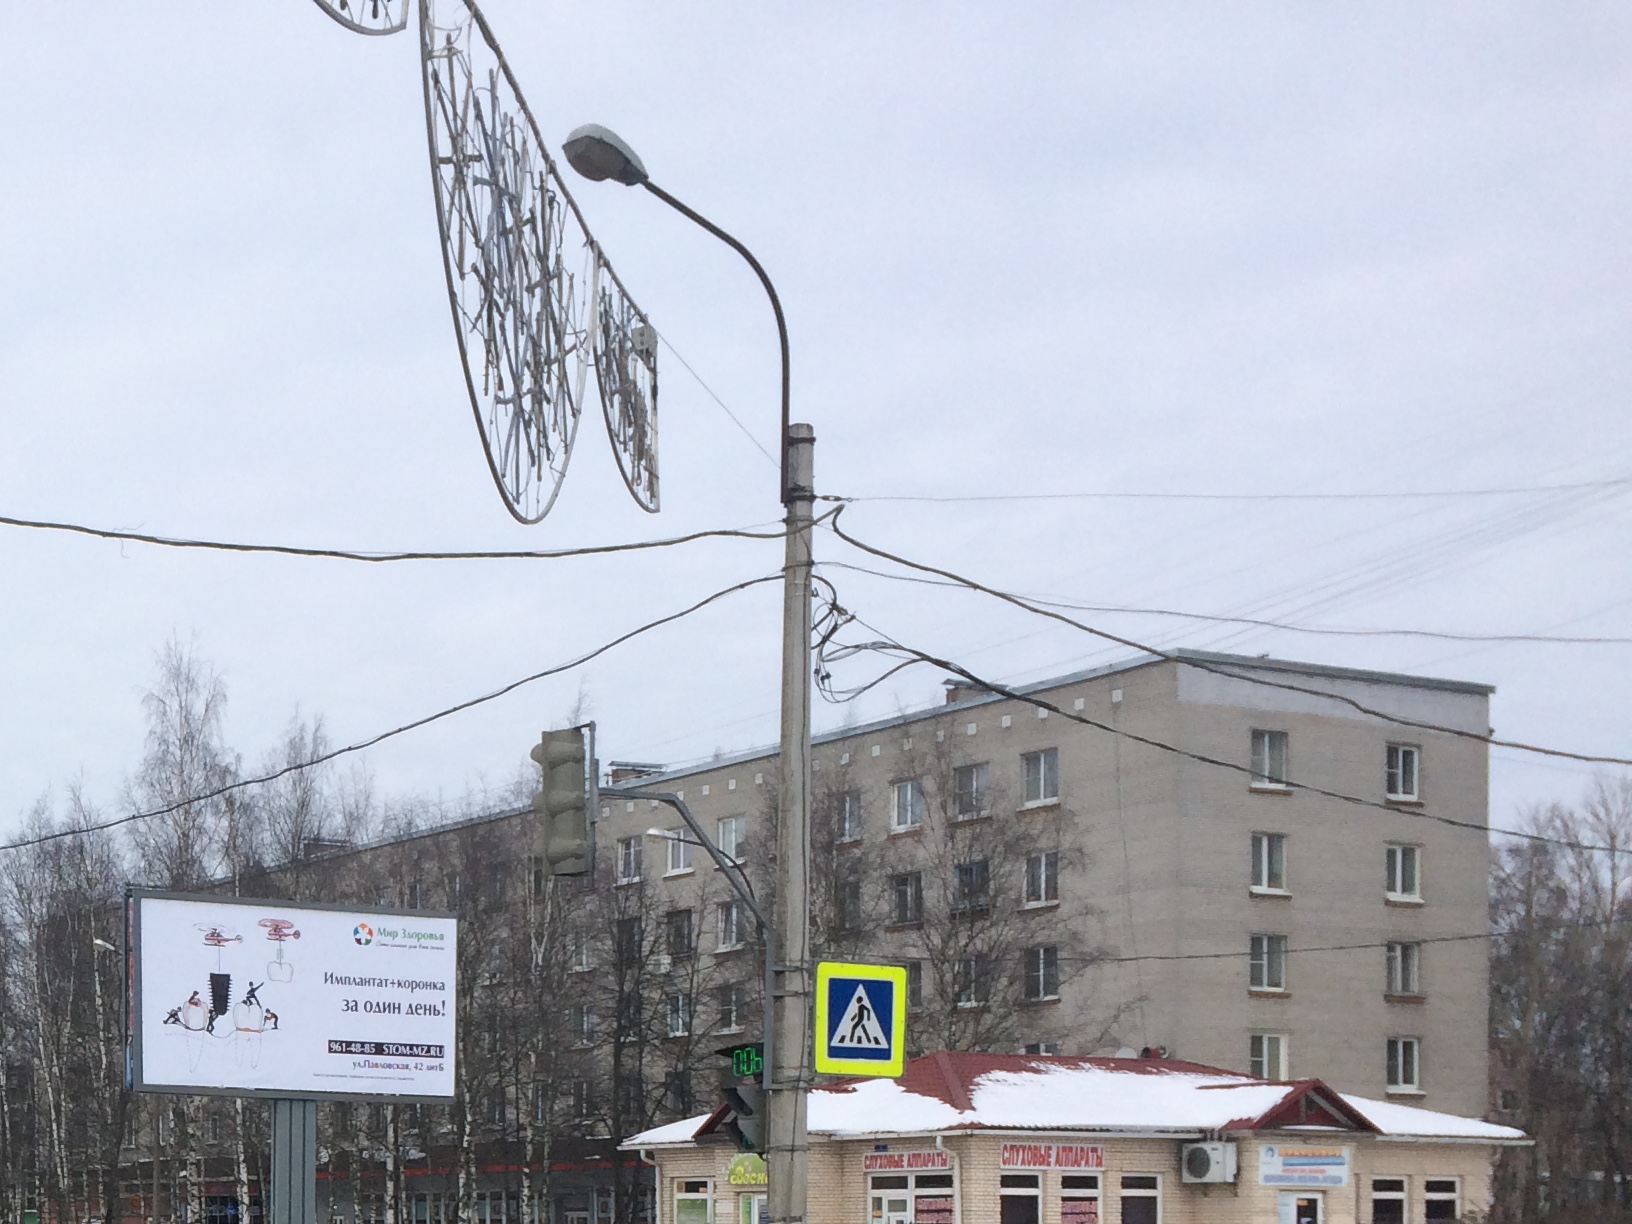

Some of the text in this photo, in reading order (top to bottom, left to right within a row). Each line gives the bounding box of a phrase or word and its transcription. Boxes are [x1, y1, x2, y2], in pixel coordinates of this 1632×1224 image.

[377, 927, 445, 942] Мир Здоровья
[324, 971, 445, 993] Имплантат+коронка
[364, 1000, 401, 1015] один
[405, 1000, 446, 1017] день!
[329, 1042, 444, 1057] 961-48-85 STOM-MZ.RU
[864, 1152, 948, 1169] СЛУХОВЫЕ АППАРАТЫ
[1002, 1144, 1103, 1168] СЛУХОВЫЕ АППАРАТЫ
